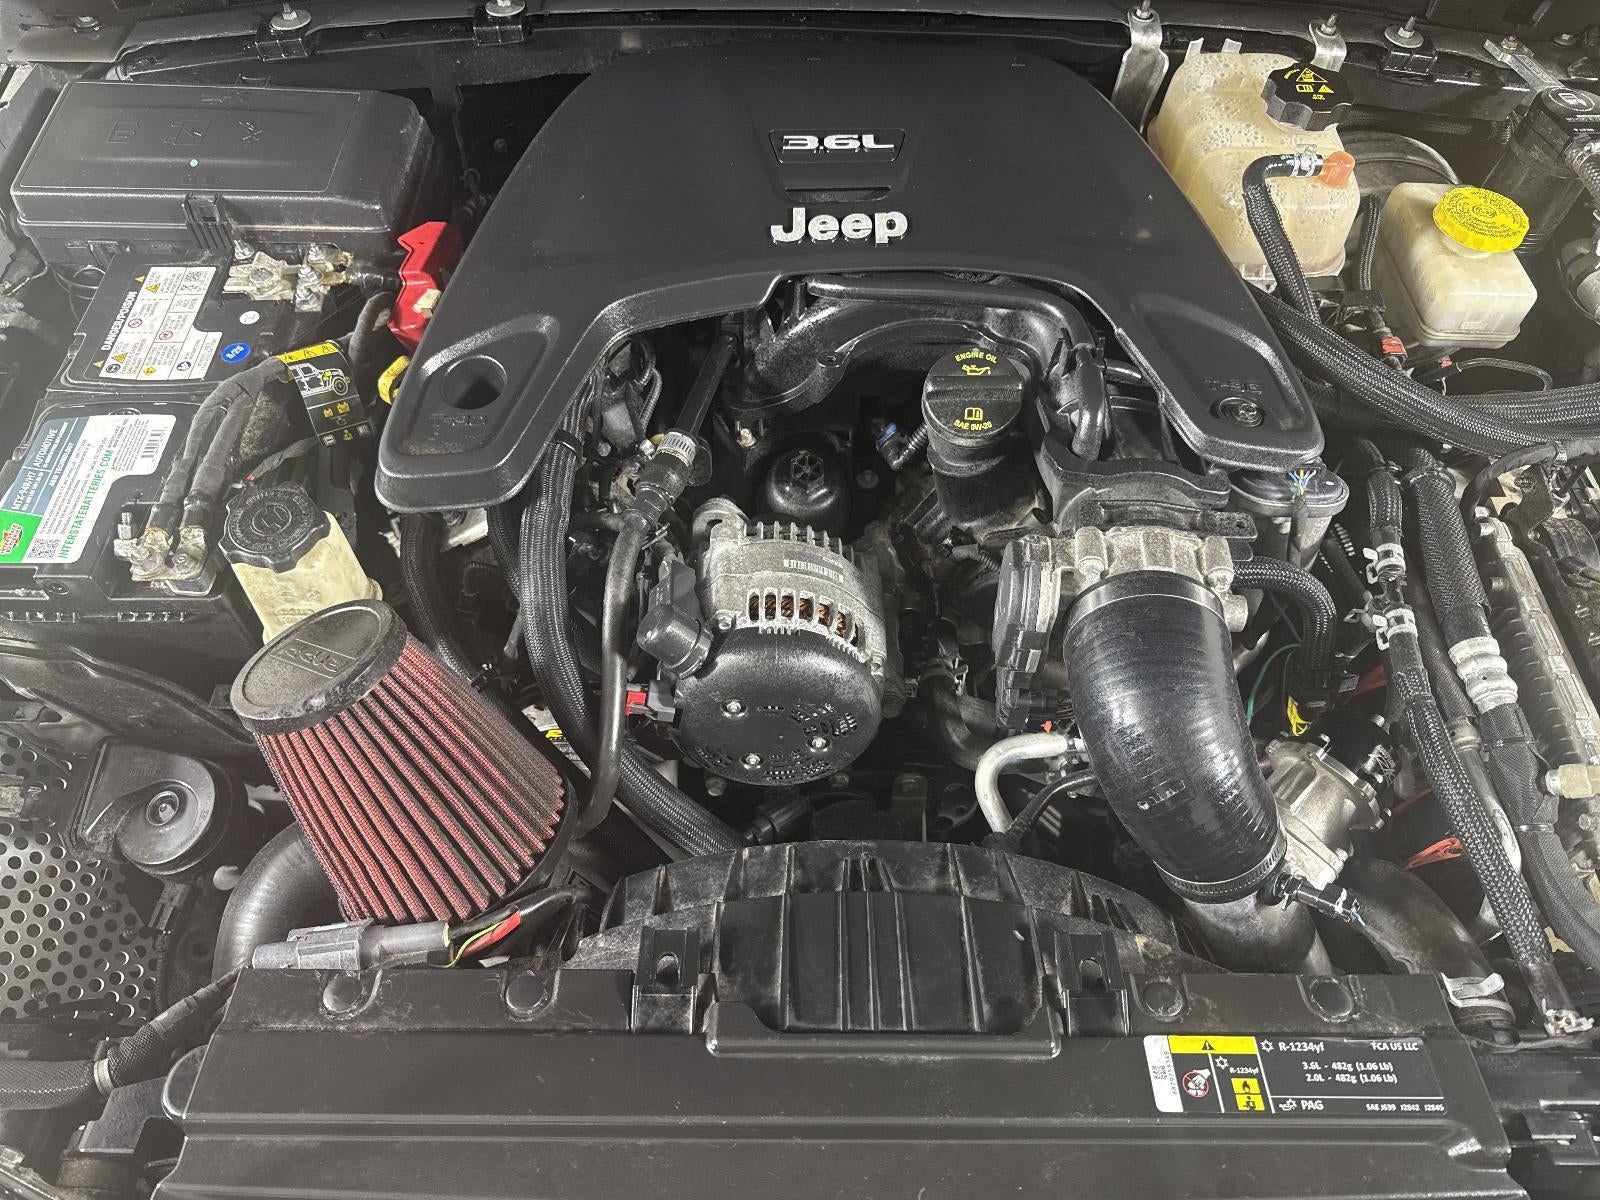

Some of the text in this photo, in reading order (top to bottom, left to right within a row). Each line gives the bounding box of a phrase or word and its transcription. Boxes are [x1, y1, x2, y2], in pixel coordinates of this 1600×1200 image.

[783, 134, 895, 150] 3.6L
[770, 207, 908, 244] Jeep
[100, 291, 138, 351] DANGER/POISON
[954, 351, 997, 364] ENGINE OIL
[953, 419, 993, 431] SAE 0W-20
[32, 427, 58, 469] AUTOMOTIVE
[58, 448, 115, 559] INTERSTATEBATTERIES.COM
[1278, 1041, 1325, 1054] R-1234yf
[1389, 1042, 1403, 1051] US
[1403, 1042, 1419, 1051] LLC
[1302, 1061, 1321, 1070] 3.6L
[1331, 1061, 1354, 1072] 482g
[1356, 1061, 1379, 1072] (1.06
[1379, 1061, 1394, 1072] Lb)
[1305, 1073, 1325, 1082] 2.0L
[1335, 1073, 1358, 1084] 482g
[1359, 1073, 1383, 1084] (1.06
[1382, 1073, 1398, 1084] Lb)
[1301, 1099, 1324, 1110] PAG
[1365, 1103, 1380, 1111] SAE
